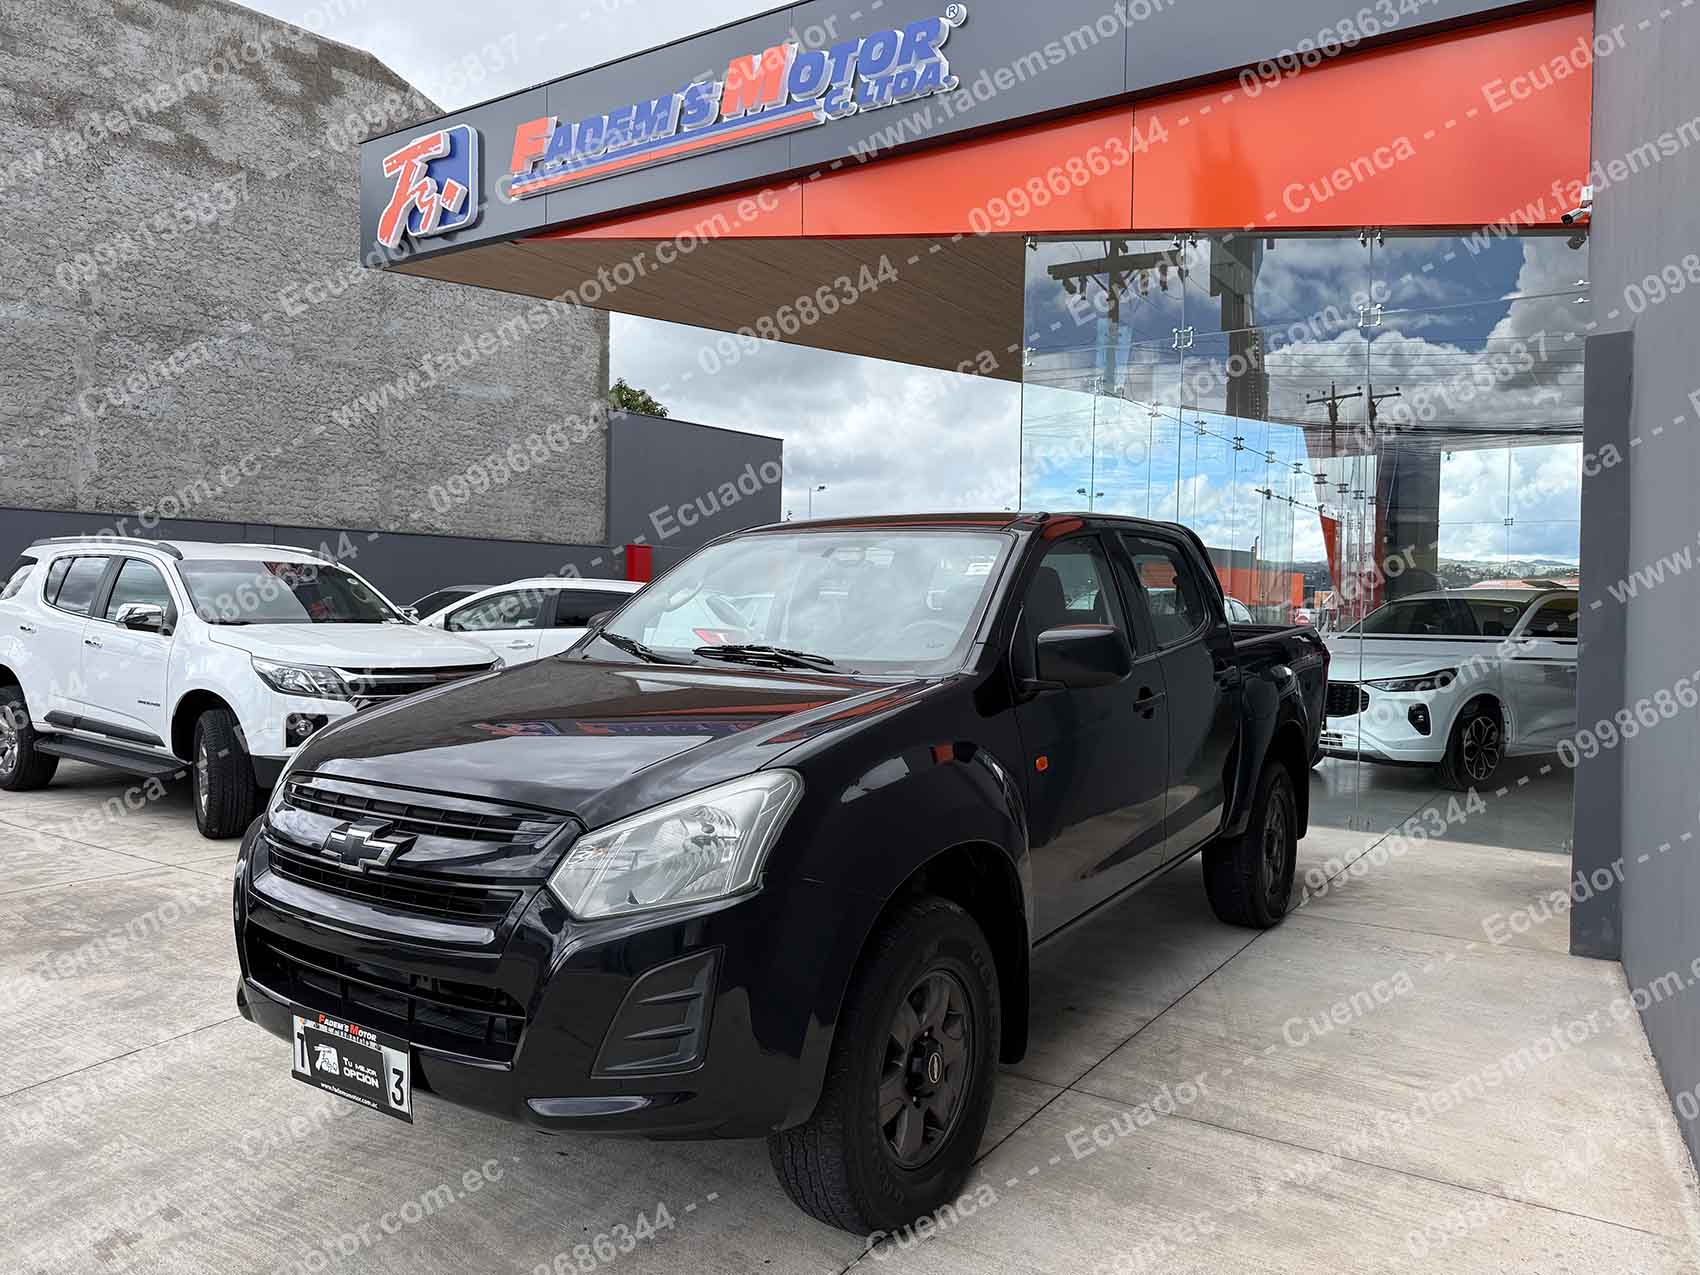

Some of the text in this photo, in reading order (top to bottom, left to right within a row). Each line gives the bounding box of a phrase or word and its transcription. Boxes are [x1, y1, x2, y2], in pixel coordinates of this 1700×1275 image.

[720, 16, 948, 119] MOTOR
[350, 1024, 377, 1041] MOTOR
[391, 1066, 404, 1106] 3
